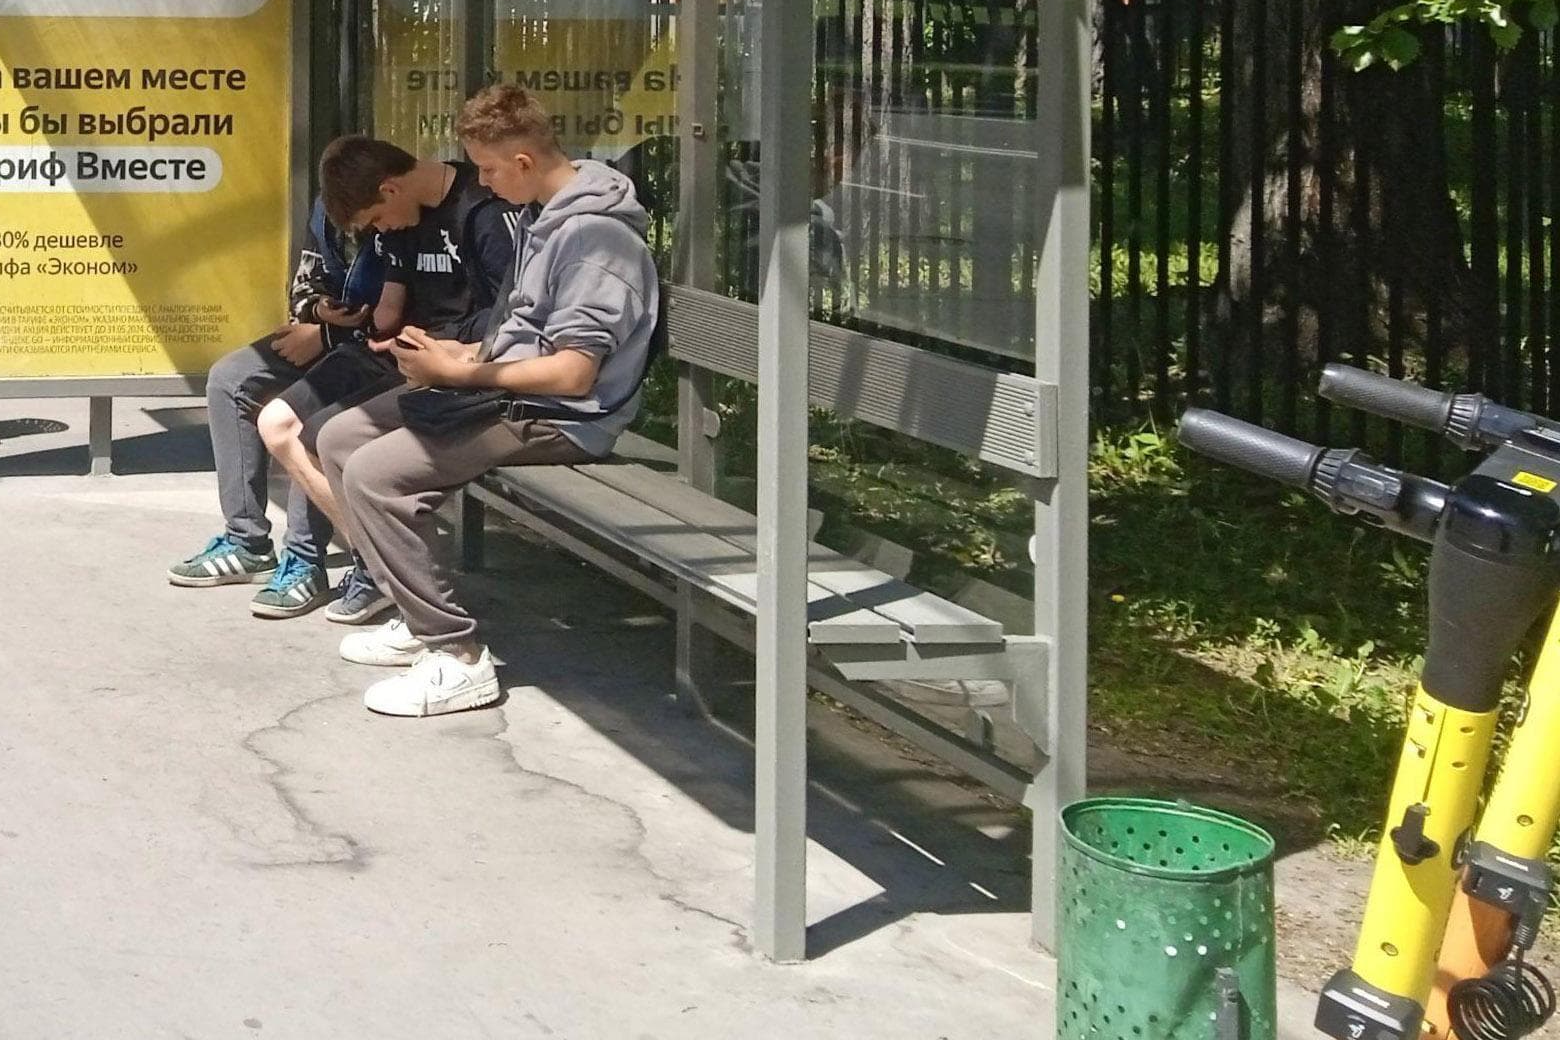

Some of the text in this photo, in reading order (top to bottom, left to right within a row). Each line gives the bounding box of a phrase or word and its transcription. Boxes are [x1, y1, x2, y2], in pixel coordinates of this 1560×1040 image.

[13, 67, 131, 90] вашем
[142, 68, 247, 91] месте
[20, 106, 67, 135] бы
[78, 106, 233, 141] выбрали
[77, 151, 206, 181] Вместе
[34, 234, 124, 252] дешевле
[37, 258, 138, 275] «Эконом»
